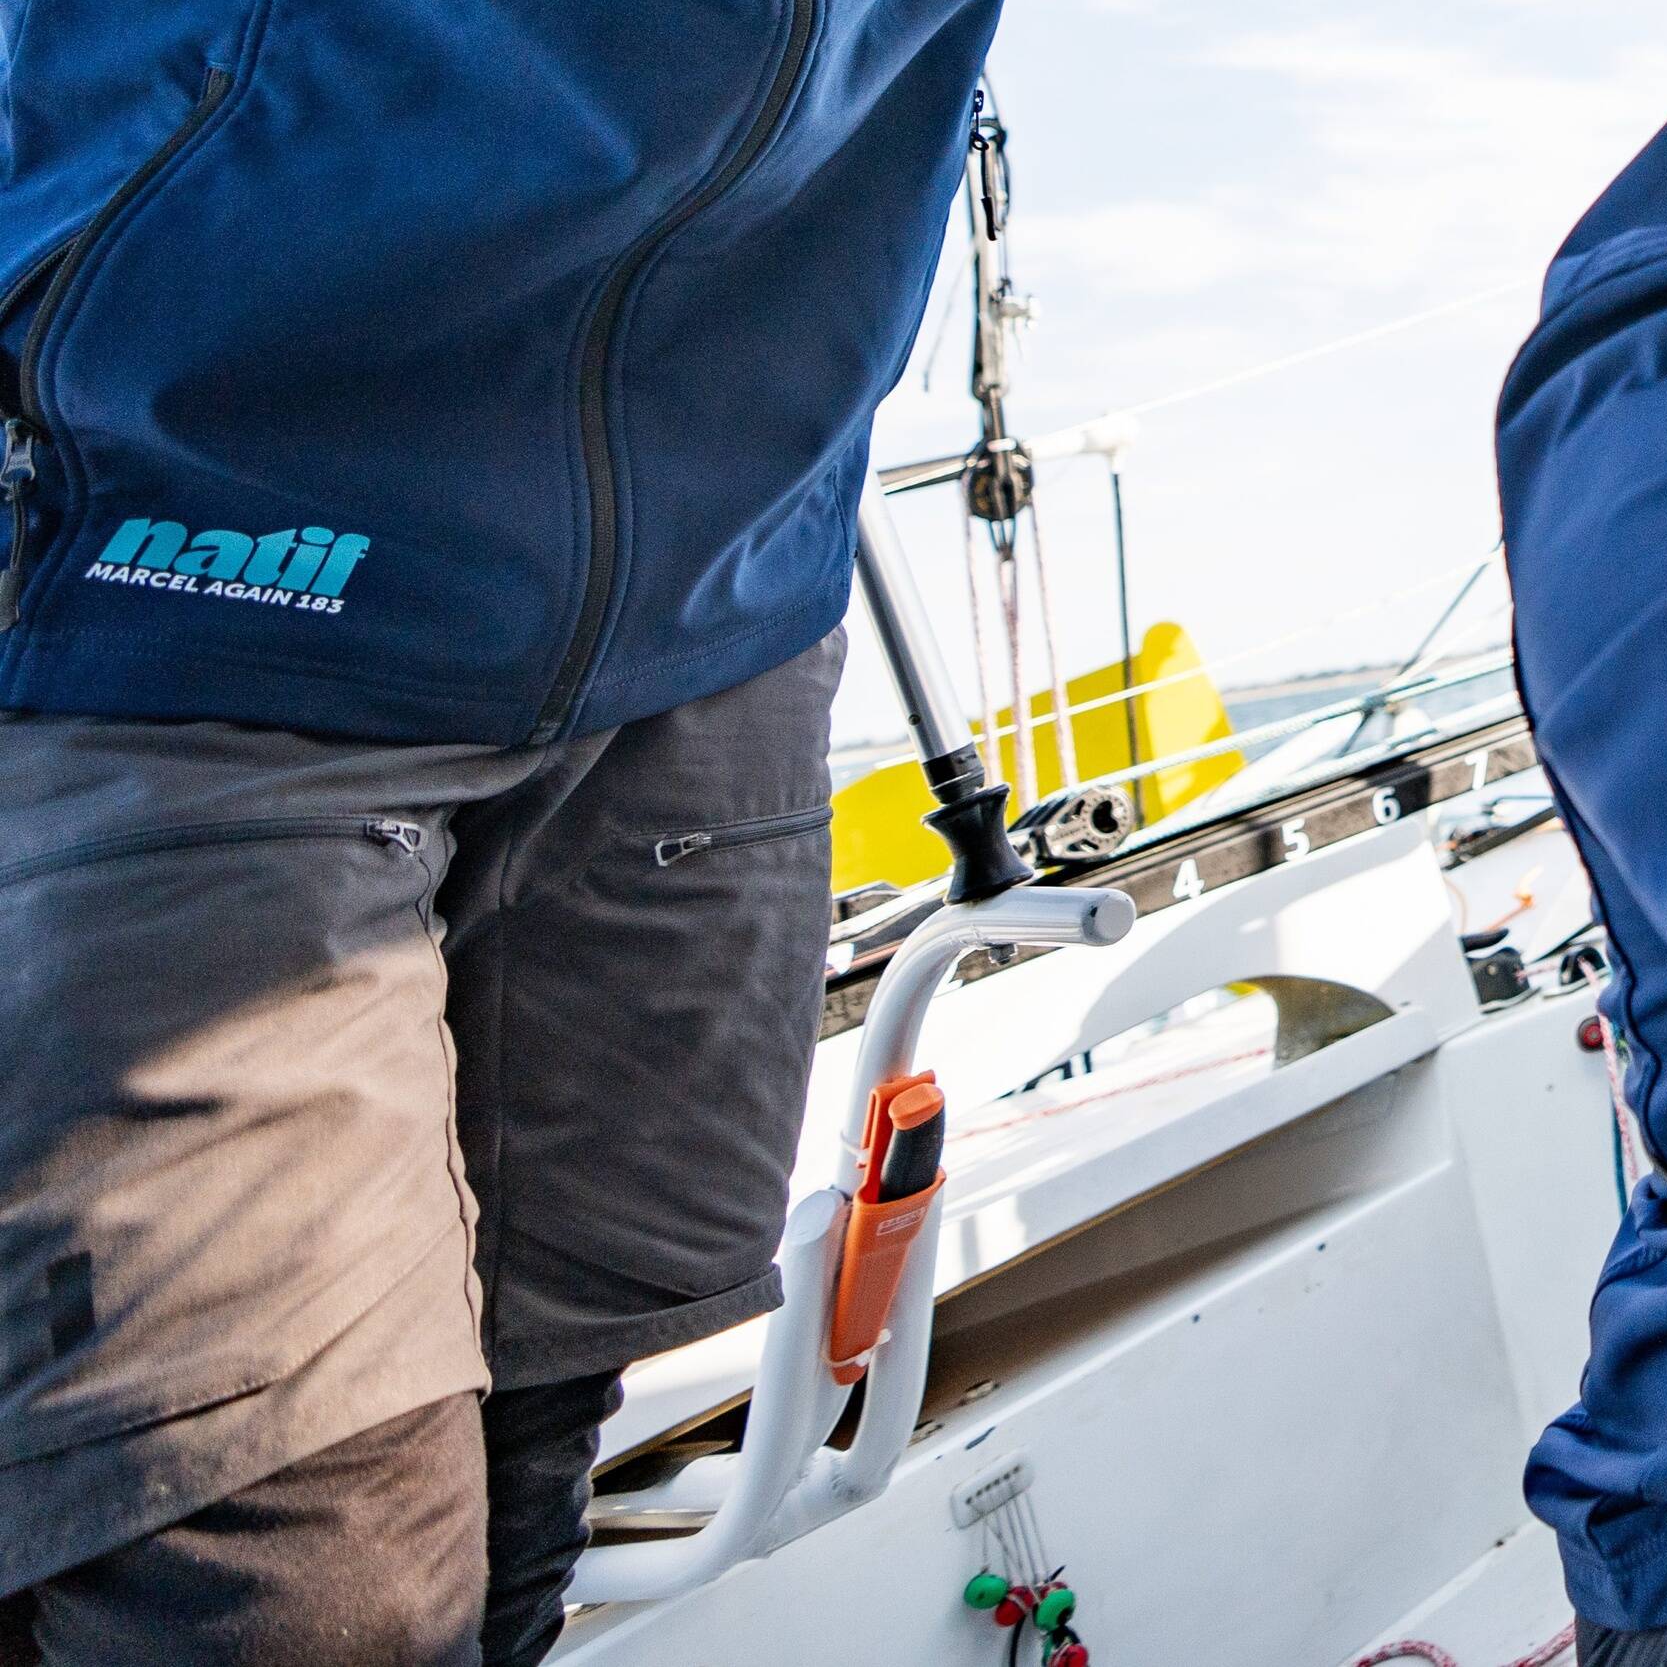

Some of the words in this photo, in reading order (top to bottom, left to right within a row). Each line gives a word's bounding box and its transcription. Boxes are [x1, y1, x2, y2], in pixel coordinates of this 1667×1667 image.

[85, 563, 199, 594] MARCEL
[203, 580, 293, 607] AGAIN
[295, 594, 346, 615] 183
[99, 518, 371, 597] natif
[1172, 858, 1205, 900] 4
[1281, 818, 1312, 862] 5
[1371, 786, 1401, 826] 6
[1464, 750, 1489, 791] 7
